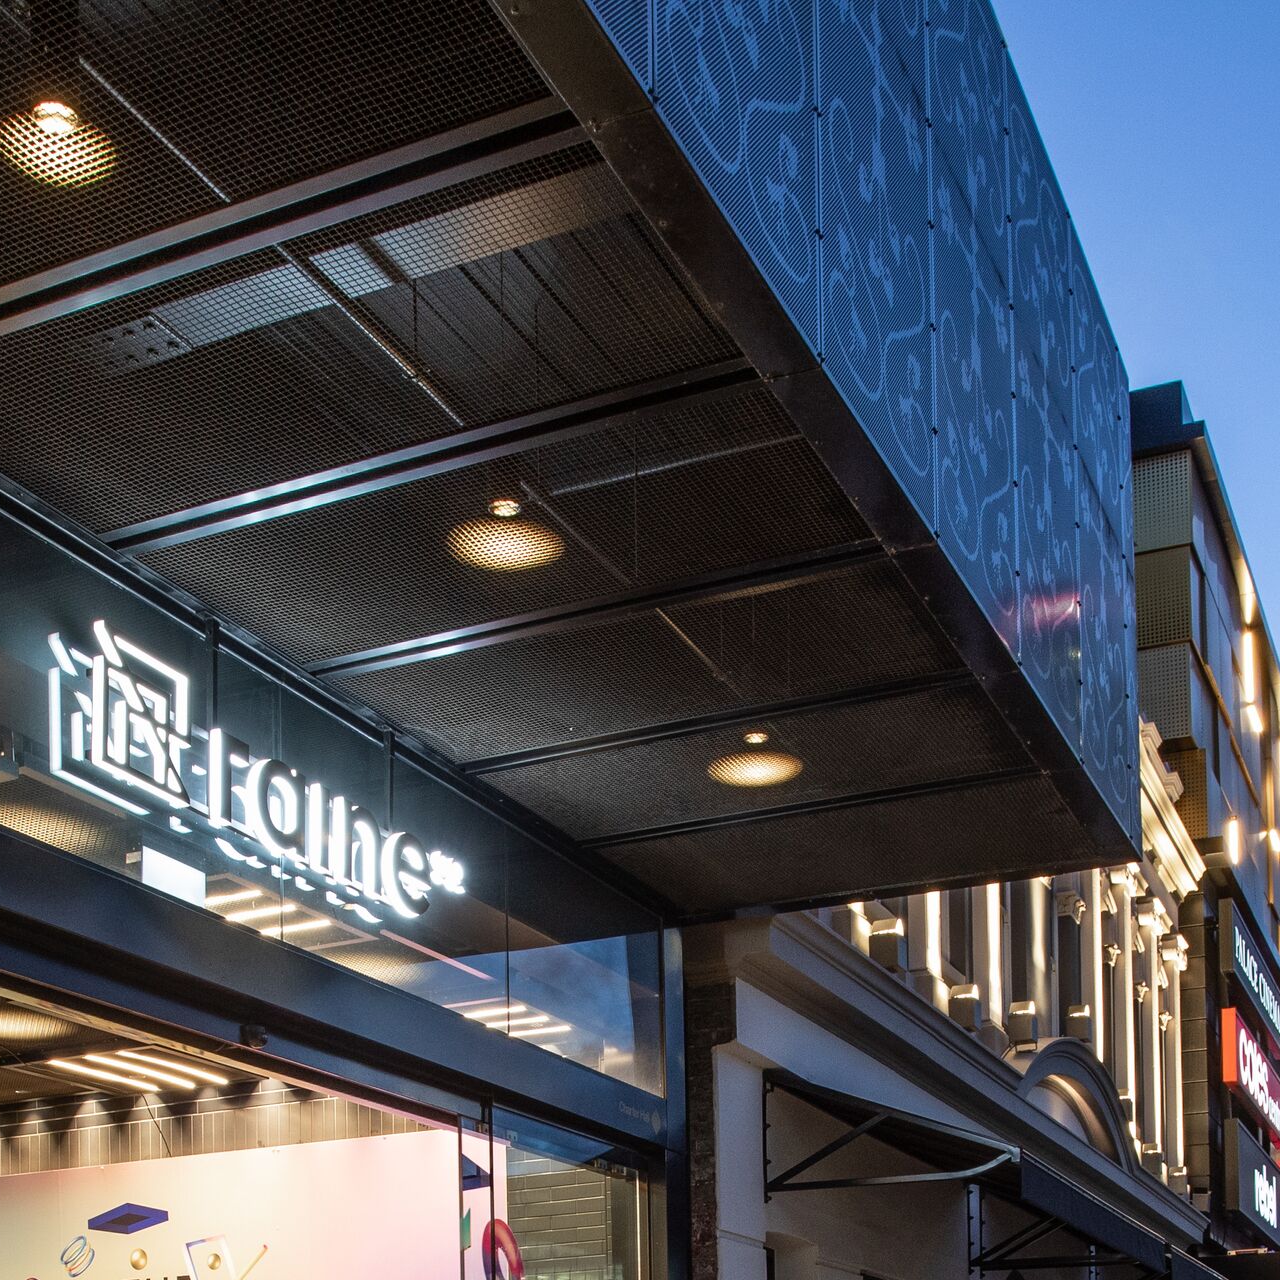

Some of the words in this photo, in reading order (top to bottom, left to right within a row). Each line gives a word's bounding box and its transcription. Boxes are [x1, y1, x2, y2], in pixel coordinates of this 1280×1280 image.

[1234, 926, 1259, 993] PALACE
[1239, 1028, 1269, 1115] coles
[1254, 1164, 1278, 1229] rebel
